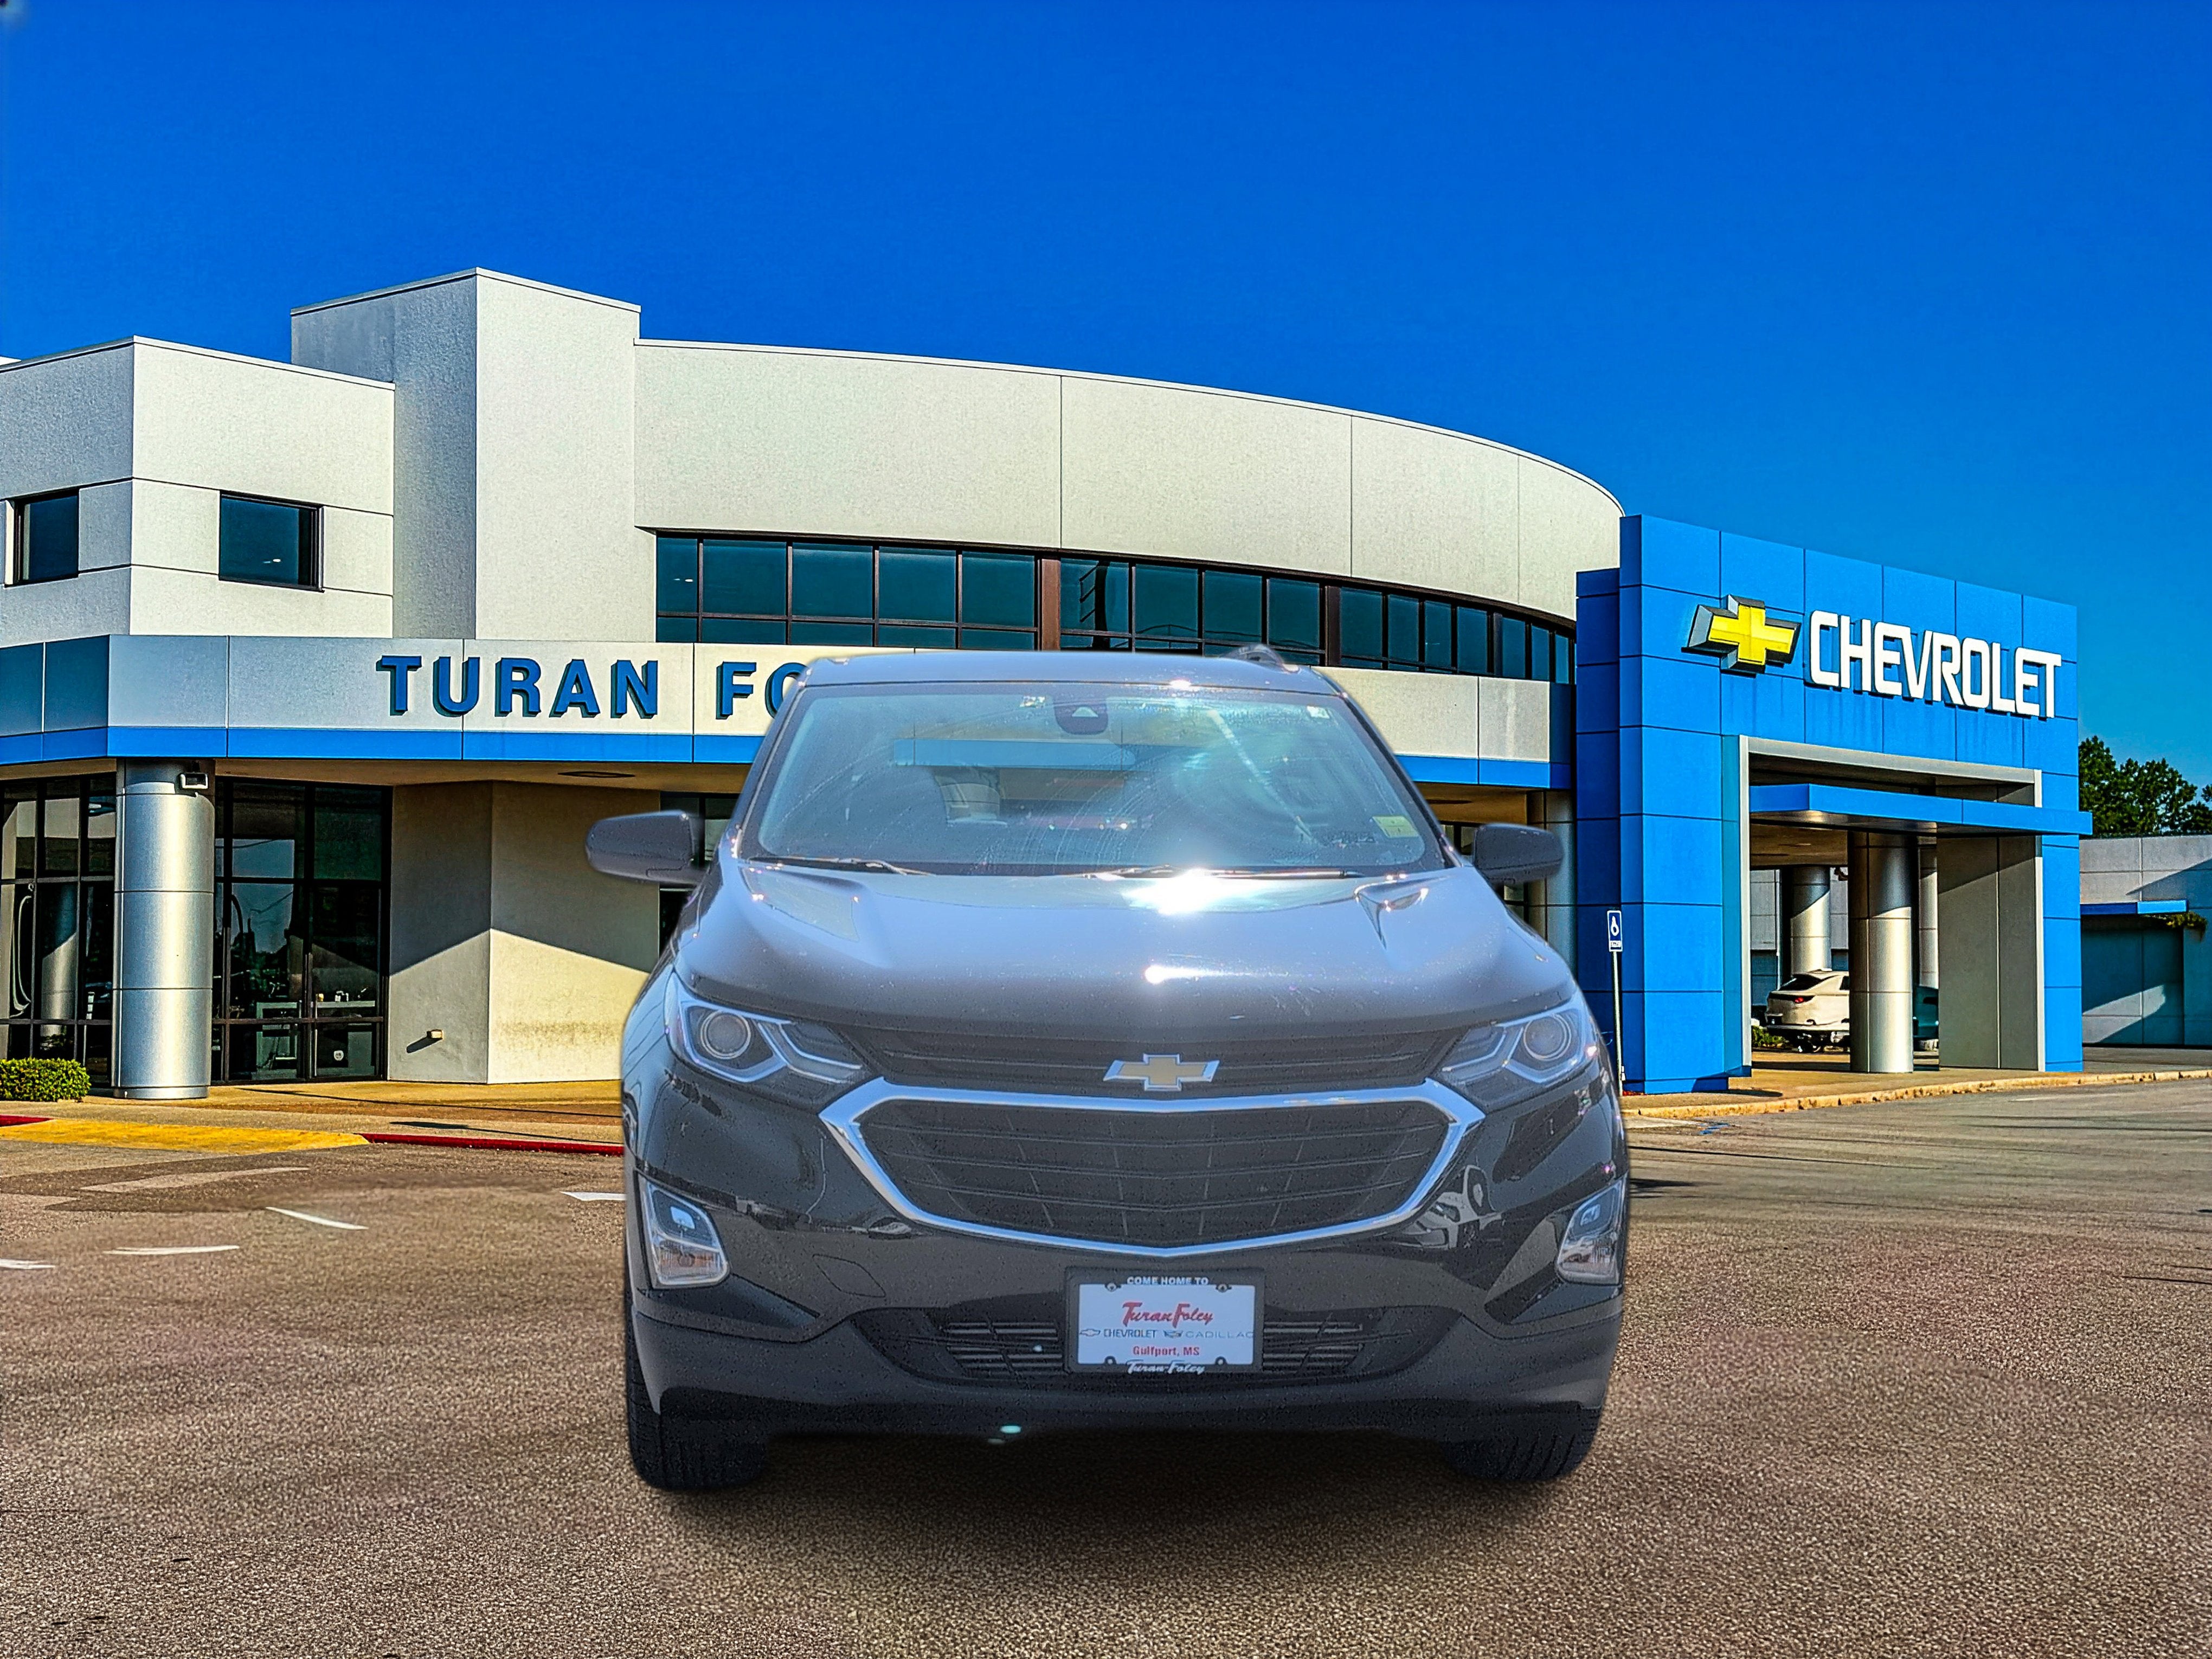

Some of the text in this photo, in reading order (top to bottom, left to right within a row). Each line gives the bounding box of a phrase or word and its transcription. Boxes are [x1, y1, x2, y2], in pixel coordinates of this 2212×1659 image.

[1810, 610, 2062, 718] CHEVROLET
[376, 655, 659, 719] TURAN
[1127, 1276, 1158, 1284] COME
[1161, 1277, 1192, 1285] HOME
[1122, 1302, 1213, 1328] Turan Foley
[1104, 1329, 1157, 1338] CHEVROLET
[1133, 1346, 1200, 1357] Gulfport, MS
